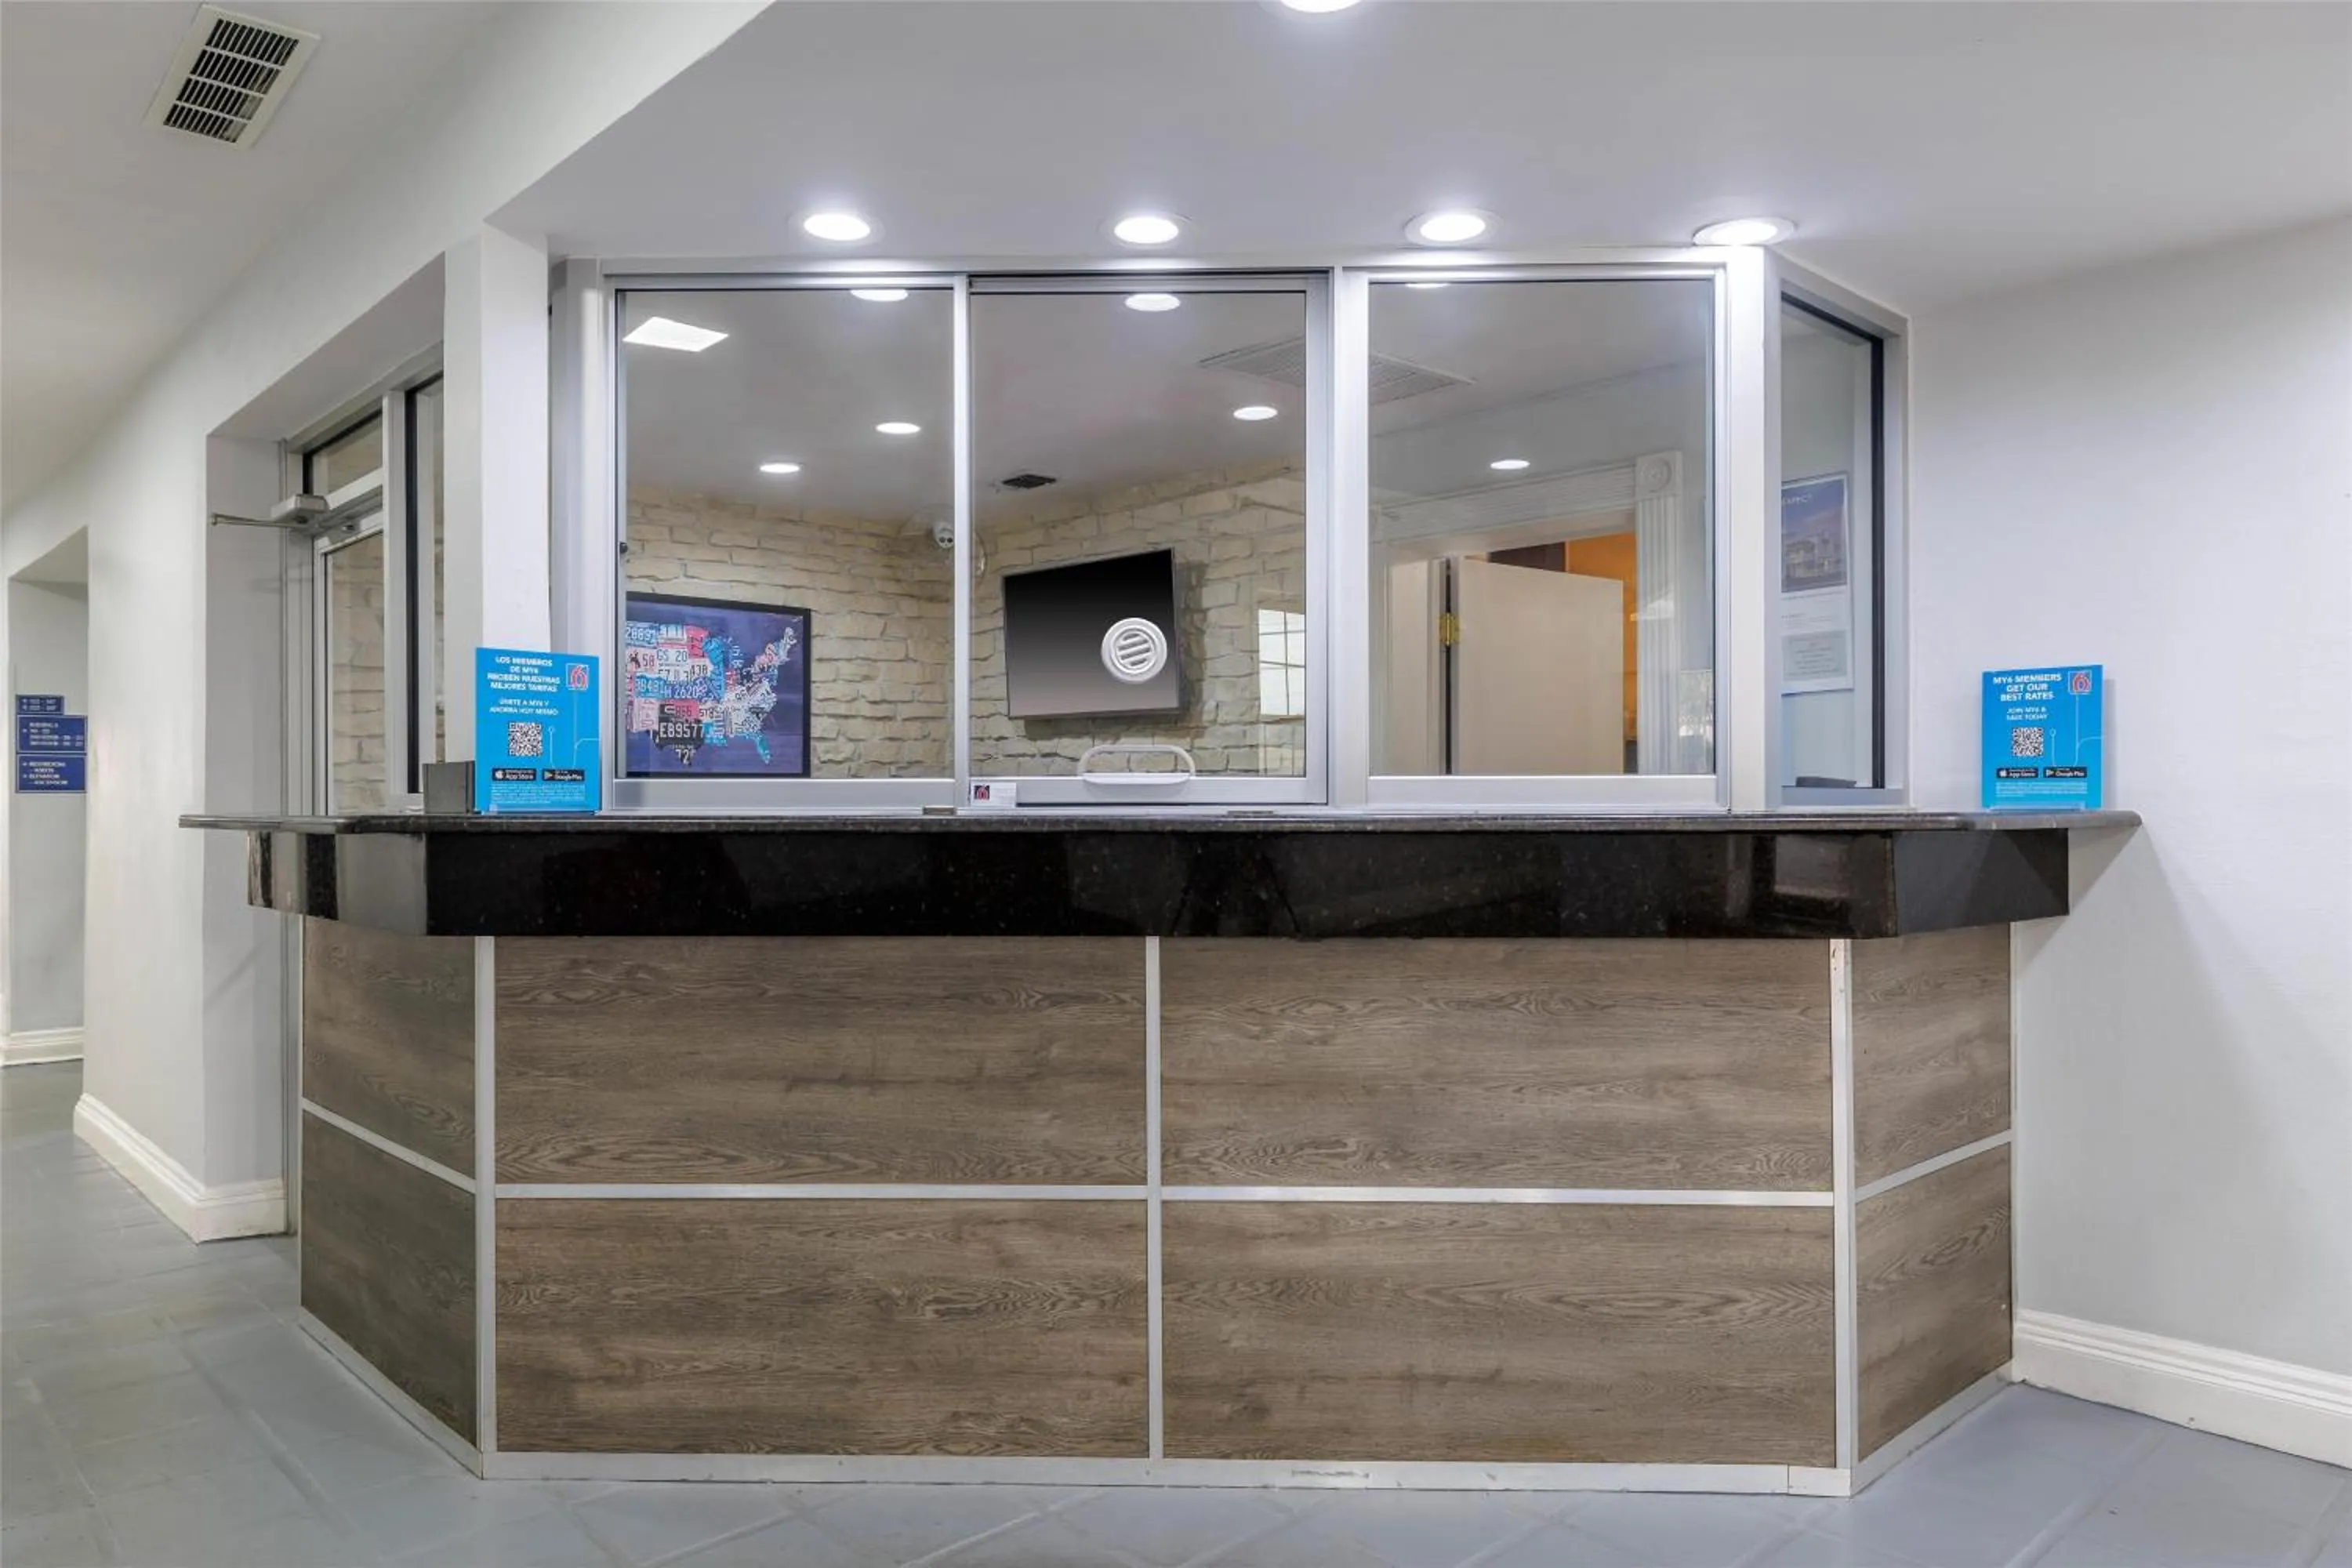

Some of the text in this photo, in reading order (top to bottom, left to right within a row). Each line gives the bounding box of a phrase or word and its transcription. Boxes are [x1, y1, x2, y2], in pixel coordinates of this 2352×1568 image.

[2015, 673, 2062, 683] MEMBERS
[490, 681, 526, 690] MEJORES
[2006, 683, 2049, 692] GET OUR
[2000, 691, 2055, 702] BEST RATES
